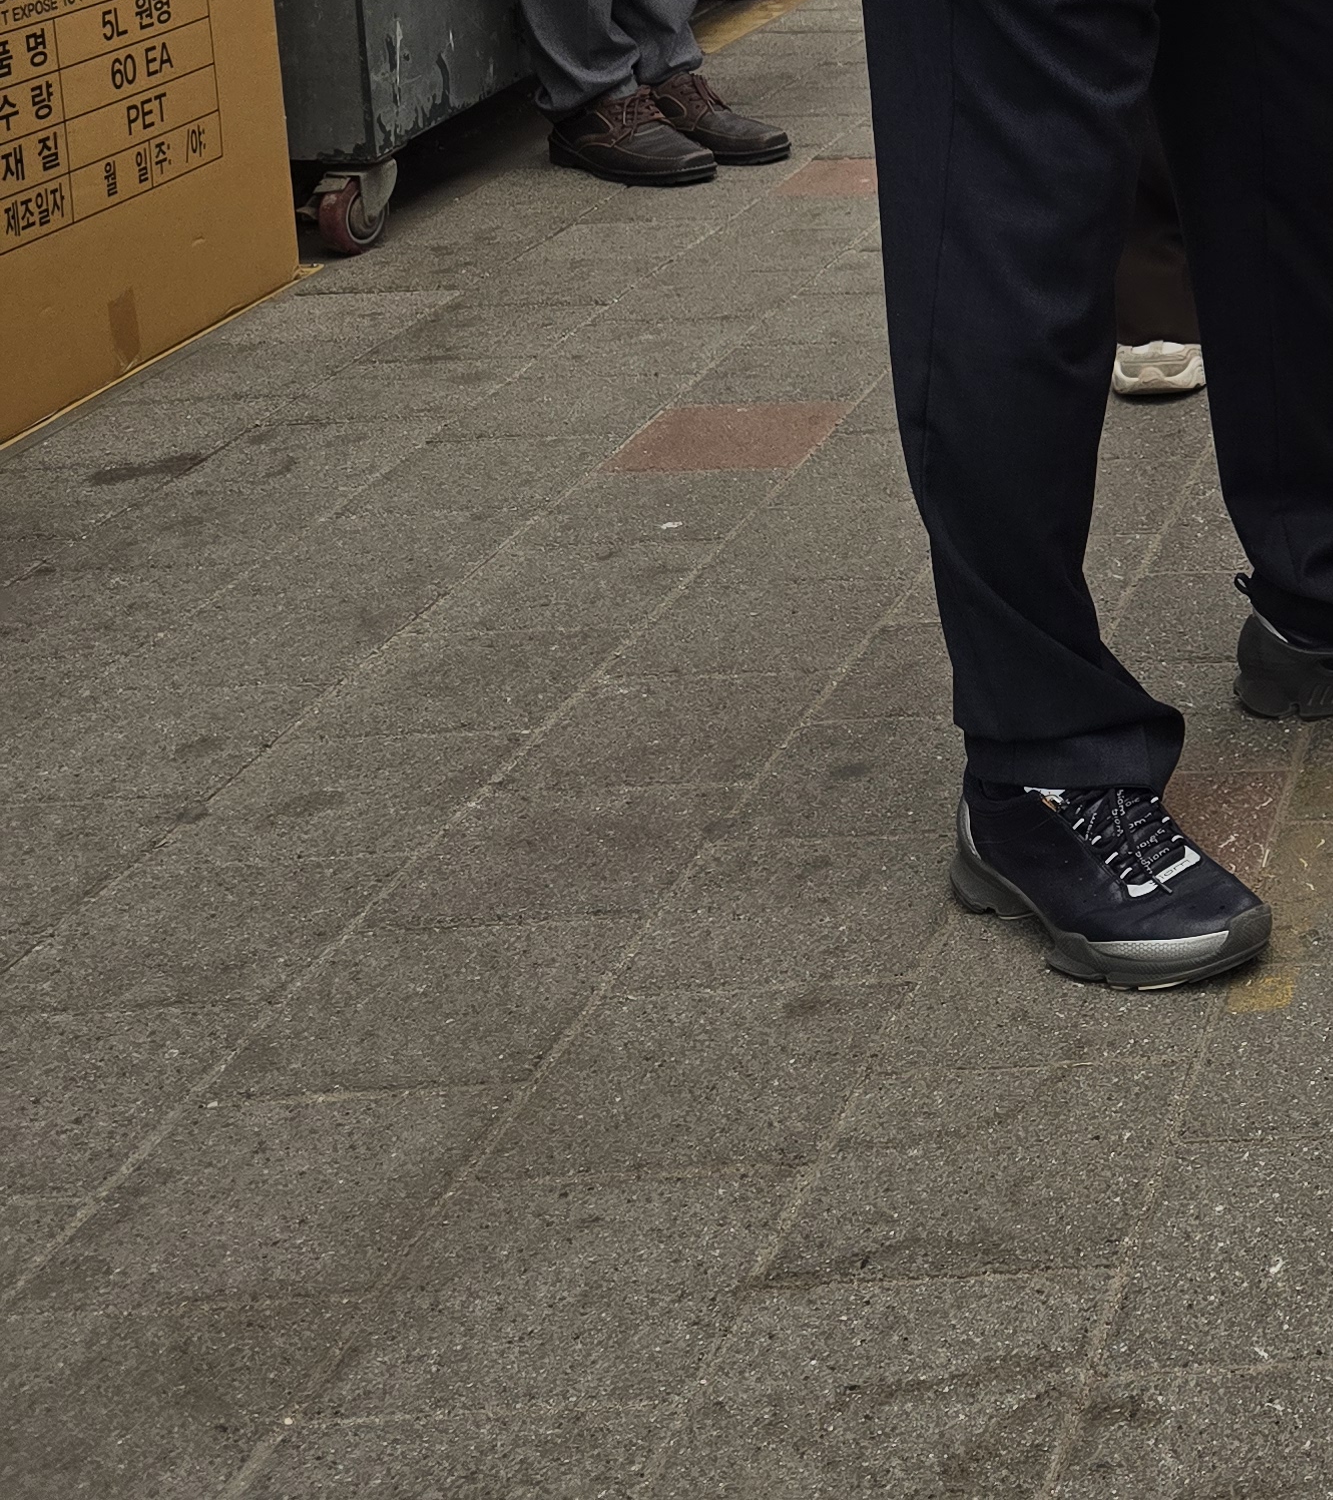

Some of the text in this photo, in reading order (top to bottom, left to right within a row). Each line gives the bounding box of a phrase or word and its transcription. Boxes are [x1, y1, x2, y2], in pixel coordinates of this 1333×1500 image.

[101, 7, 129, 42] 5L
[110, 41, 174, 90] 60 EA
[126, 91, 167, 136] PET
[4, 181, 66, 237] 제조일자
